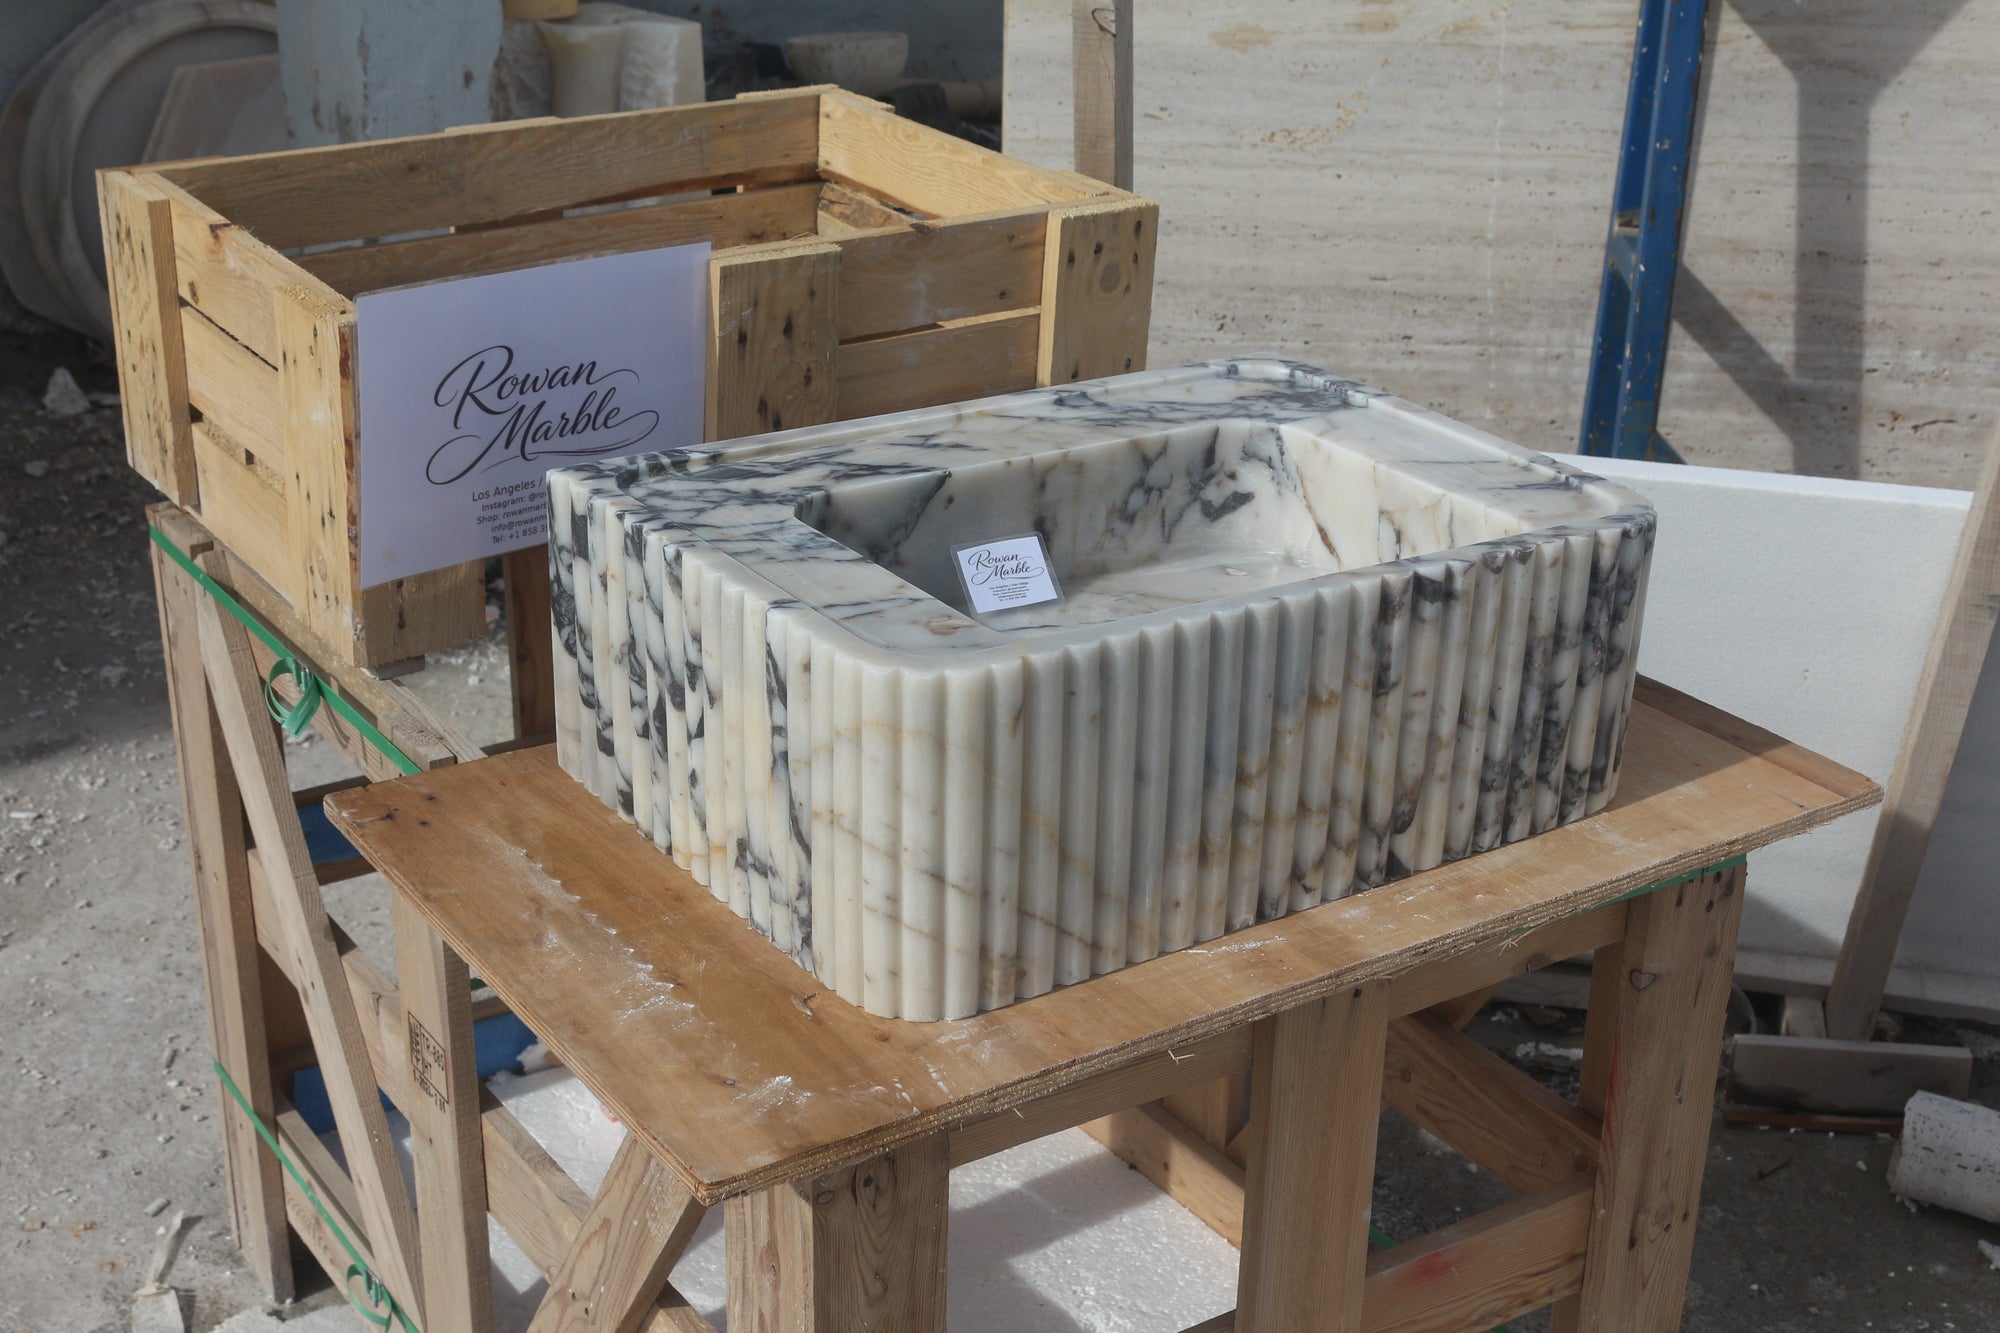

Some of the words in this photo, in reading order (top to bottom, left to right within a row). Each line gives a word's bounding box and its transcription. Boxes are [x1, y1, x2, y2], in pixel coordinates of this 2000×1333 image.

[434, 345, 640, 429] Rowan
[426, 387, 660, 485] Marble
[472, 490, 490, 502] Los
[493, 479, 536, 497] Angeles
[538, 476, 543, 487] /
[481, 495, 526, 512] Instagram:
[476, 513, 499, 525] Shop:
[491, 535, 505, 544] Tel:
[508, 531, 520, 539] +1
[968, 549, 1034, 571] Rowan
[971, 561, 1045, 585] Marble
